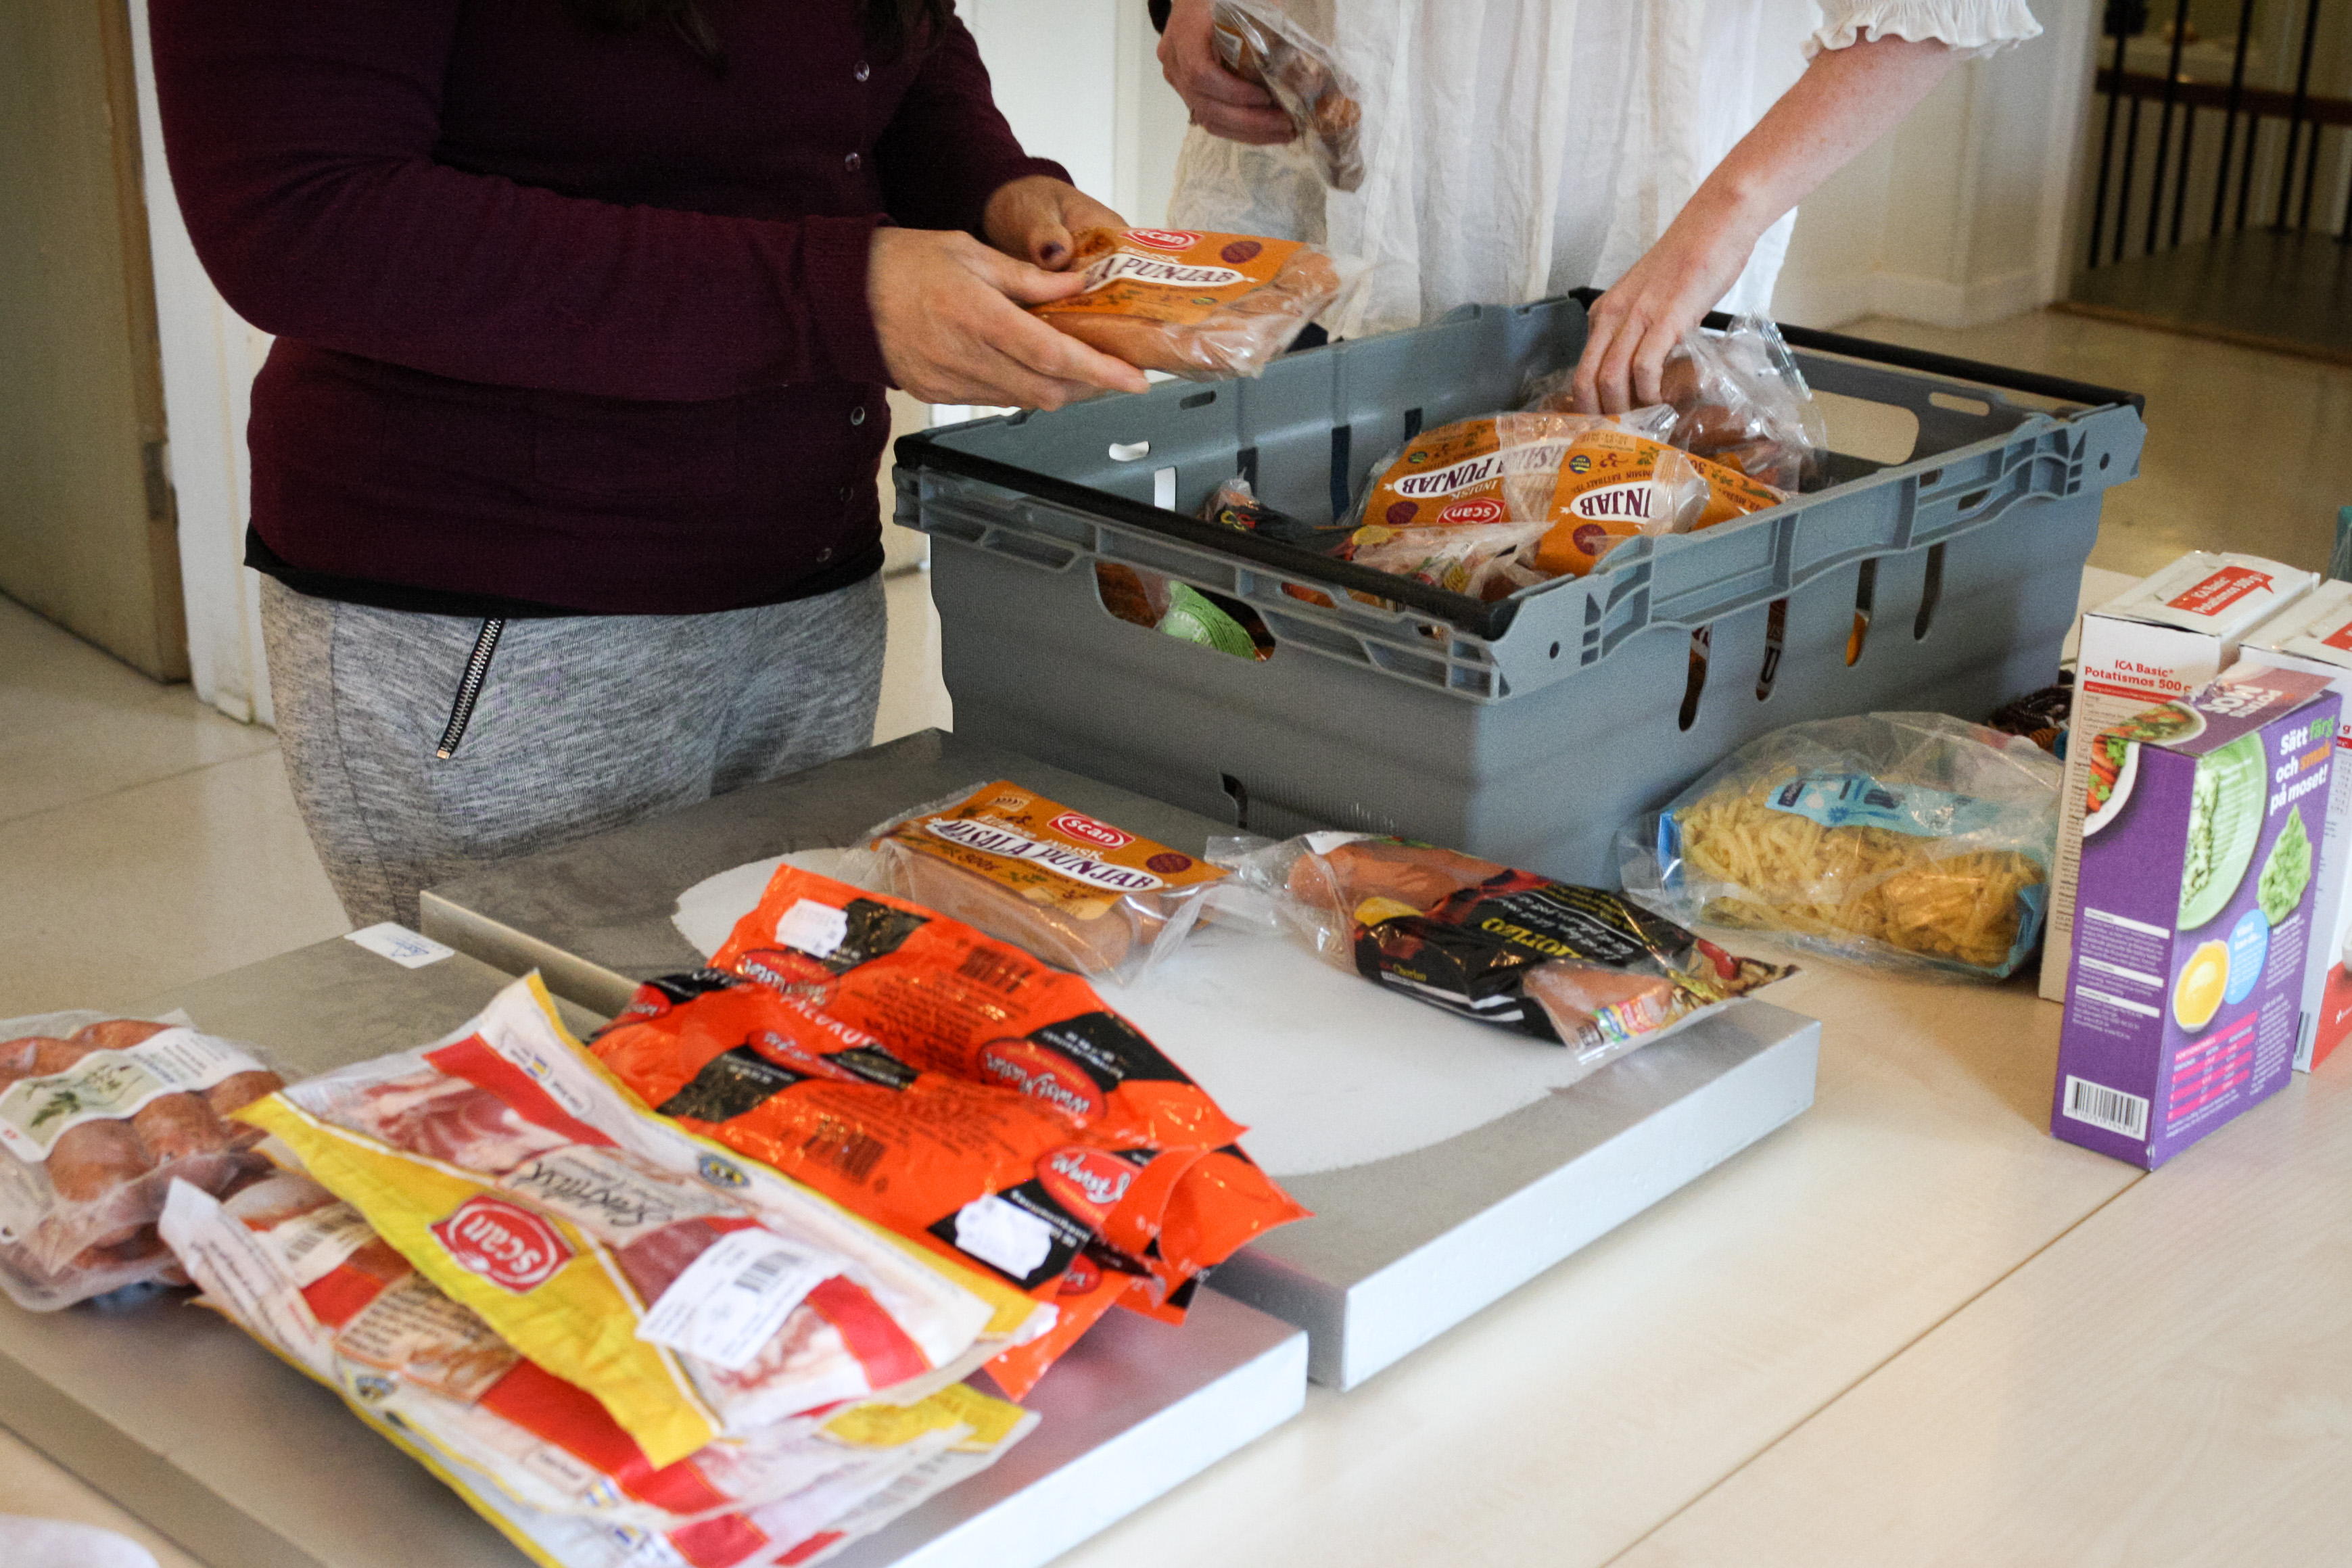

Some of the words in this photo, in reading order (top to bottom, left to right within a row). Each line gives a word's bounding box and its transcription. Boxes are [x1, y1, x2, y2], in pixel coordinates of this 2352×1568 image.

[1114, 257, 1236, 283] PUNJAB
[1402, 456, 1495, 494] PUNJAB
[1451, 506, 1492, 519] scan
[2085, 666, 2155, 687] Potatismos
[2159, 678, 2182, 692] 500
[2115, 659, 2134, 671] ICA
[2280, 726, 2309, 756] Sätt
[2275, 755, 2299, 784] och
[2269, 782, 2287, 817] på
[2287, 763, 2329, 803] moset!
[1066, 818, 1116, 845] scan
[1031, 847, 1156, 889] PUNJAB
[462, 1214, 542, 1274] scan
